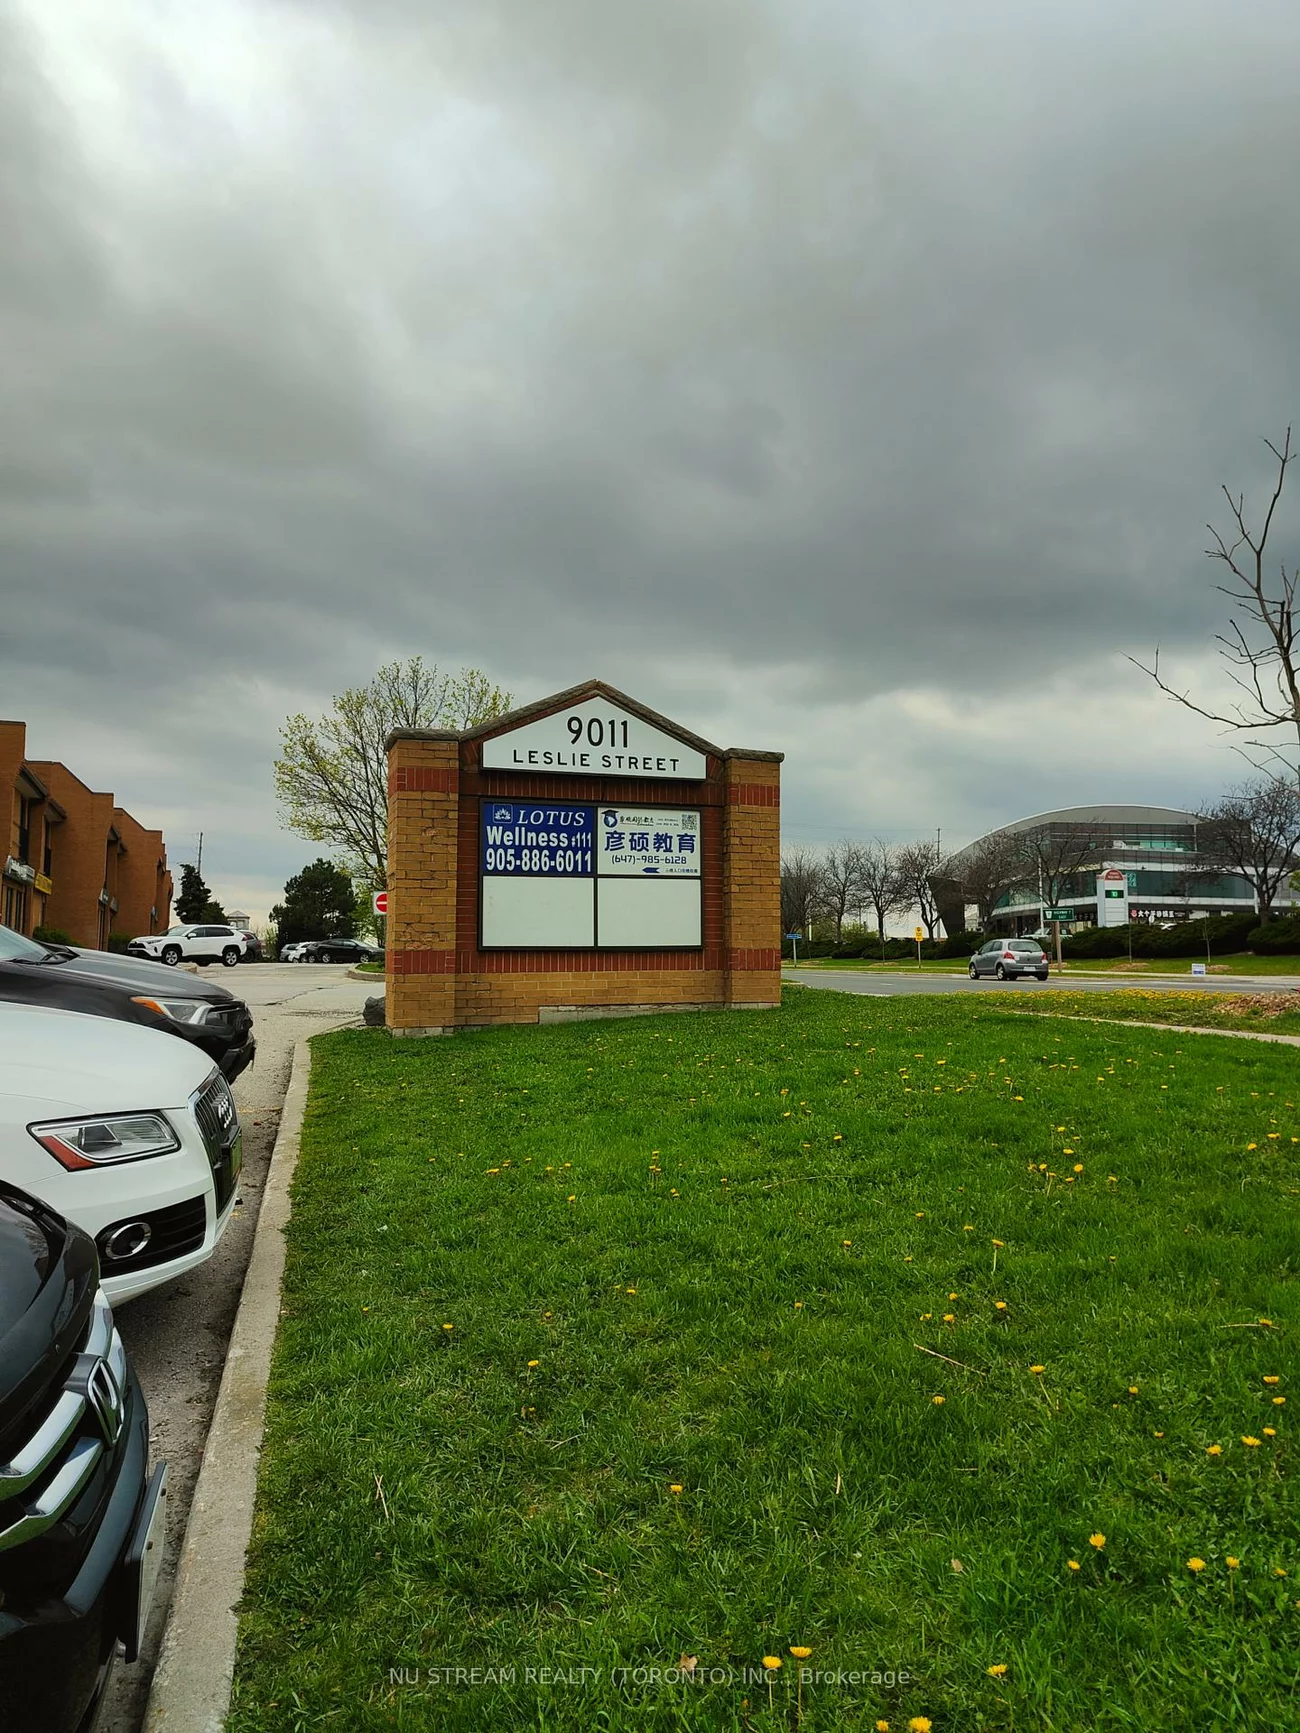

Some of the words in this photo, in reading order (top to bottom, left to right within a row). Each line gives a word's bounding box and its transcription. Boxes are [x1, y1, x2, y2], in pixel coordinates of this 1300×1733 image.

[567, 716, 629, 748] 9011
[513, 749, 590, 767] LESLIE
[602, 754, 680, 772] STREET
[518, 809, 585, 826] LOTUS
[486, 826, 568, 847] Wellness
[604, 830, 697, 854] 彦硕教育
[486, 848, 592, 872] 905-886-6011
[611, 854, 687, 865] (647)-985-6128
